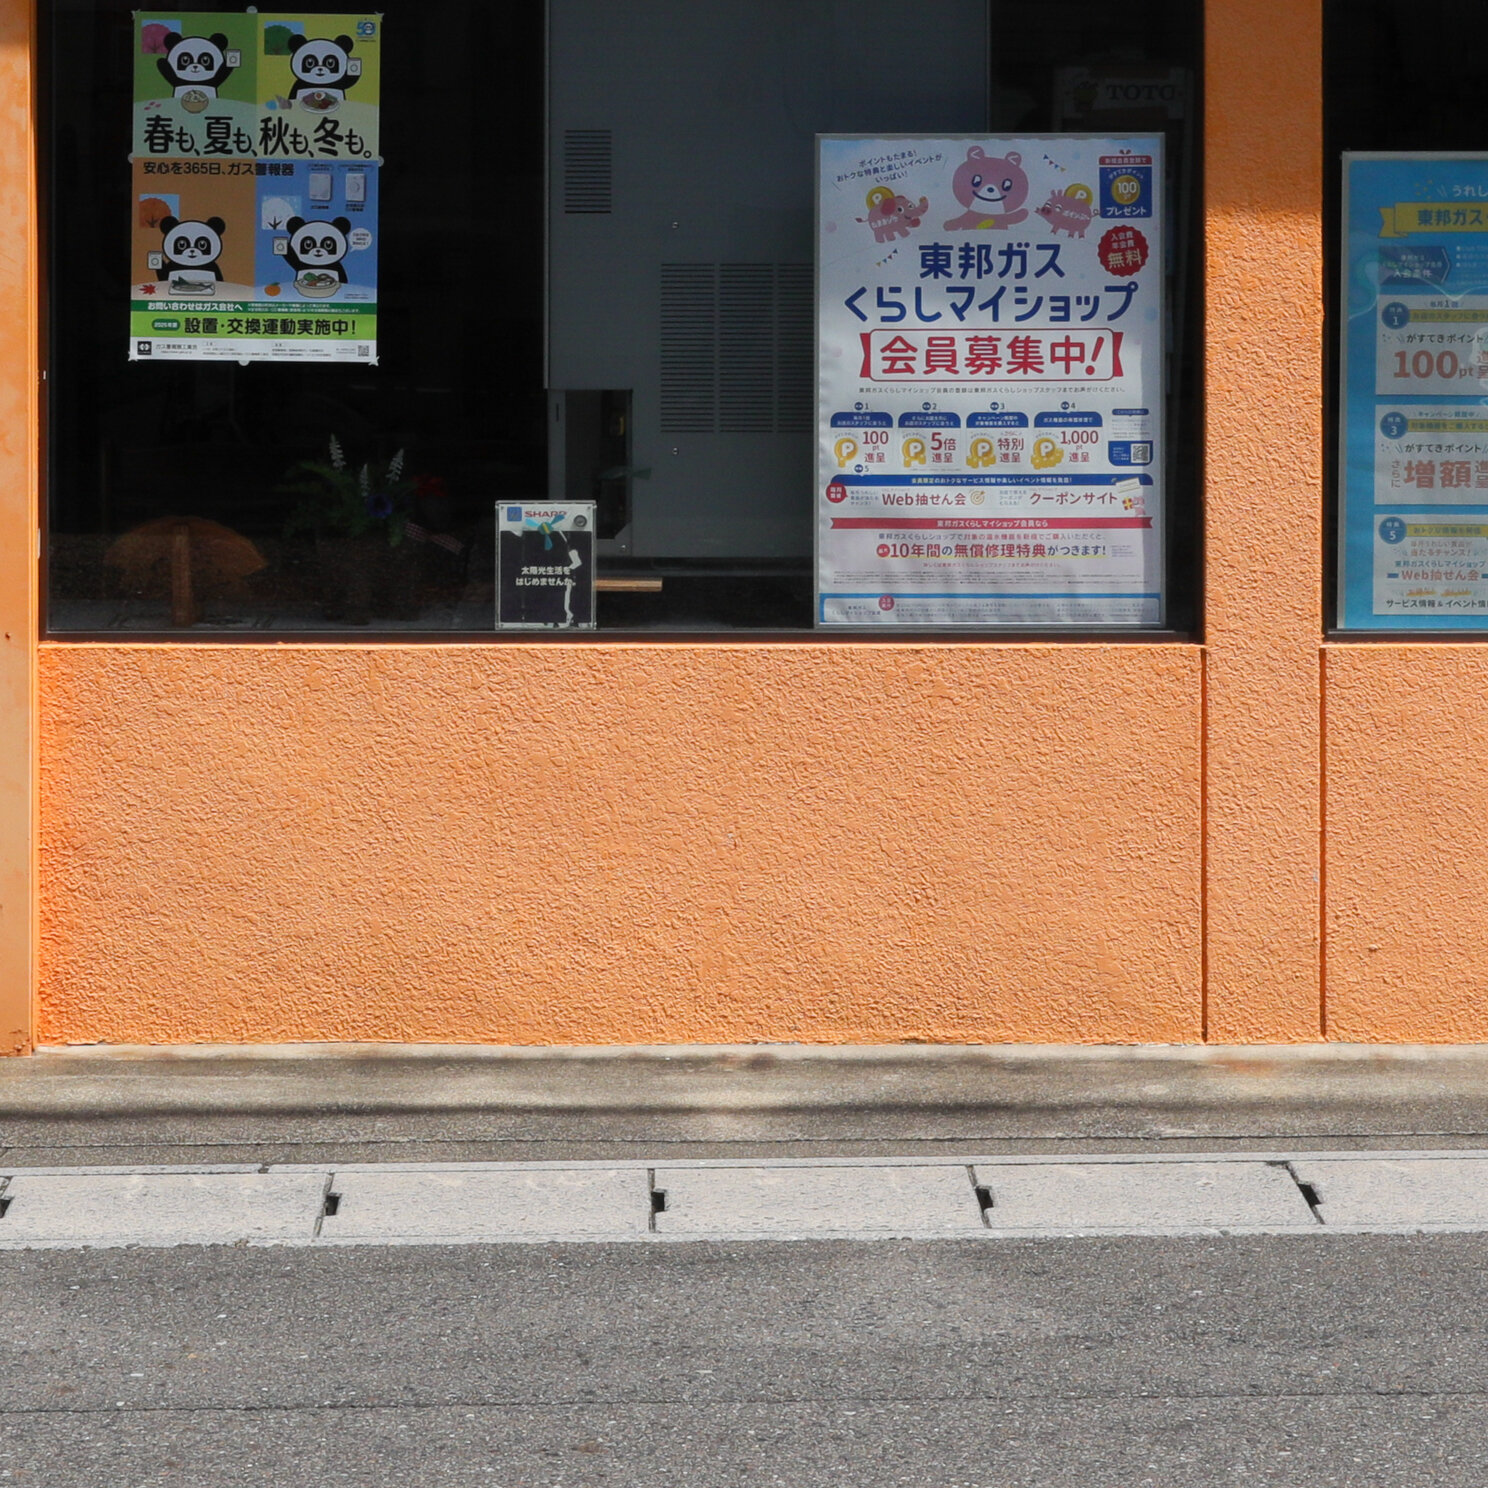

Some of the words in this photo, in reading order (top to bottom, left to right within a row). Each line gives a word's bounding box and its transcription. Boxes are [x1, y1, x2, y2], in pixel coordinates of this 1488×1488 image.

[144, 115, 372, 158] 春も、夏も、秋も、冬も。
[143, 162, 294, 176] 安心を365日、ガス警報器
[1118, 182, 1137, 194] 100
[1106, 206, 1147, 216] プレゼント
[919, 241, 1066, 280] 東邦ガス
[1107, 249, 1142, 269] 無料
[147, 301, 243, 312] お問い合わせはガス会社へ
[844, 281, 1139, 323] くらしマイショップ
[184, 318, 357, 336] 設置・交換運動実施中！
[1407, 333, 1484, 344] がすてきポイント
[880, 334, 1105, 376] 会員募集中！
[1390, 425, 1398, 436] 3
[863, 431, 889, 444] 100
[930, 432, 956, 451] 5倍
[1060, 430, 1099, 445] 1,000
[997, 438, 1024, 451] 特別
[1405, 444, 1482, 453] がすてきポイント
[865, 453, 886, 463] 進呈
[932, 453, 953, 463] 進呈
[1000, 452, 1021, 462] 進呈
[1069, 452, 1090, 462] 進呈
[1404, 460, 1471, 489] 増額
[1030, 492, 1118, 505] クーポンサイト
[1389, 530, 1397, 540] 5
[521, 566, 571, 575] 太陽光生活を
[515, 577, 576, 586] はじめませんか。
